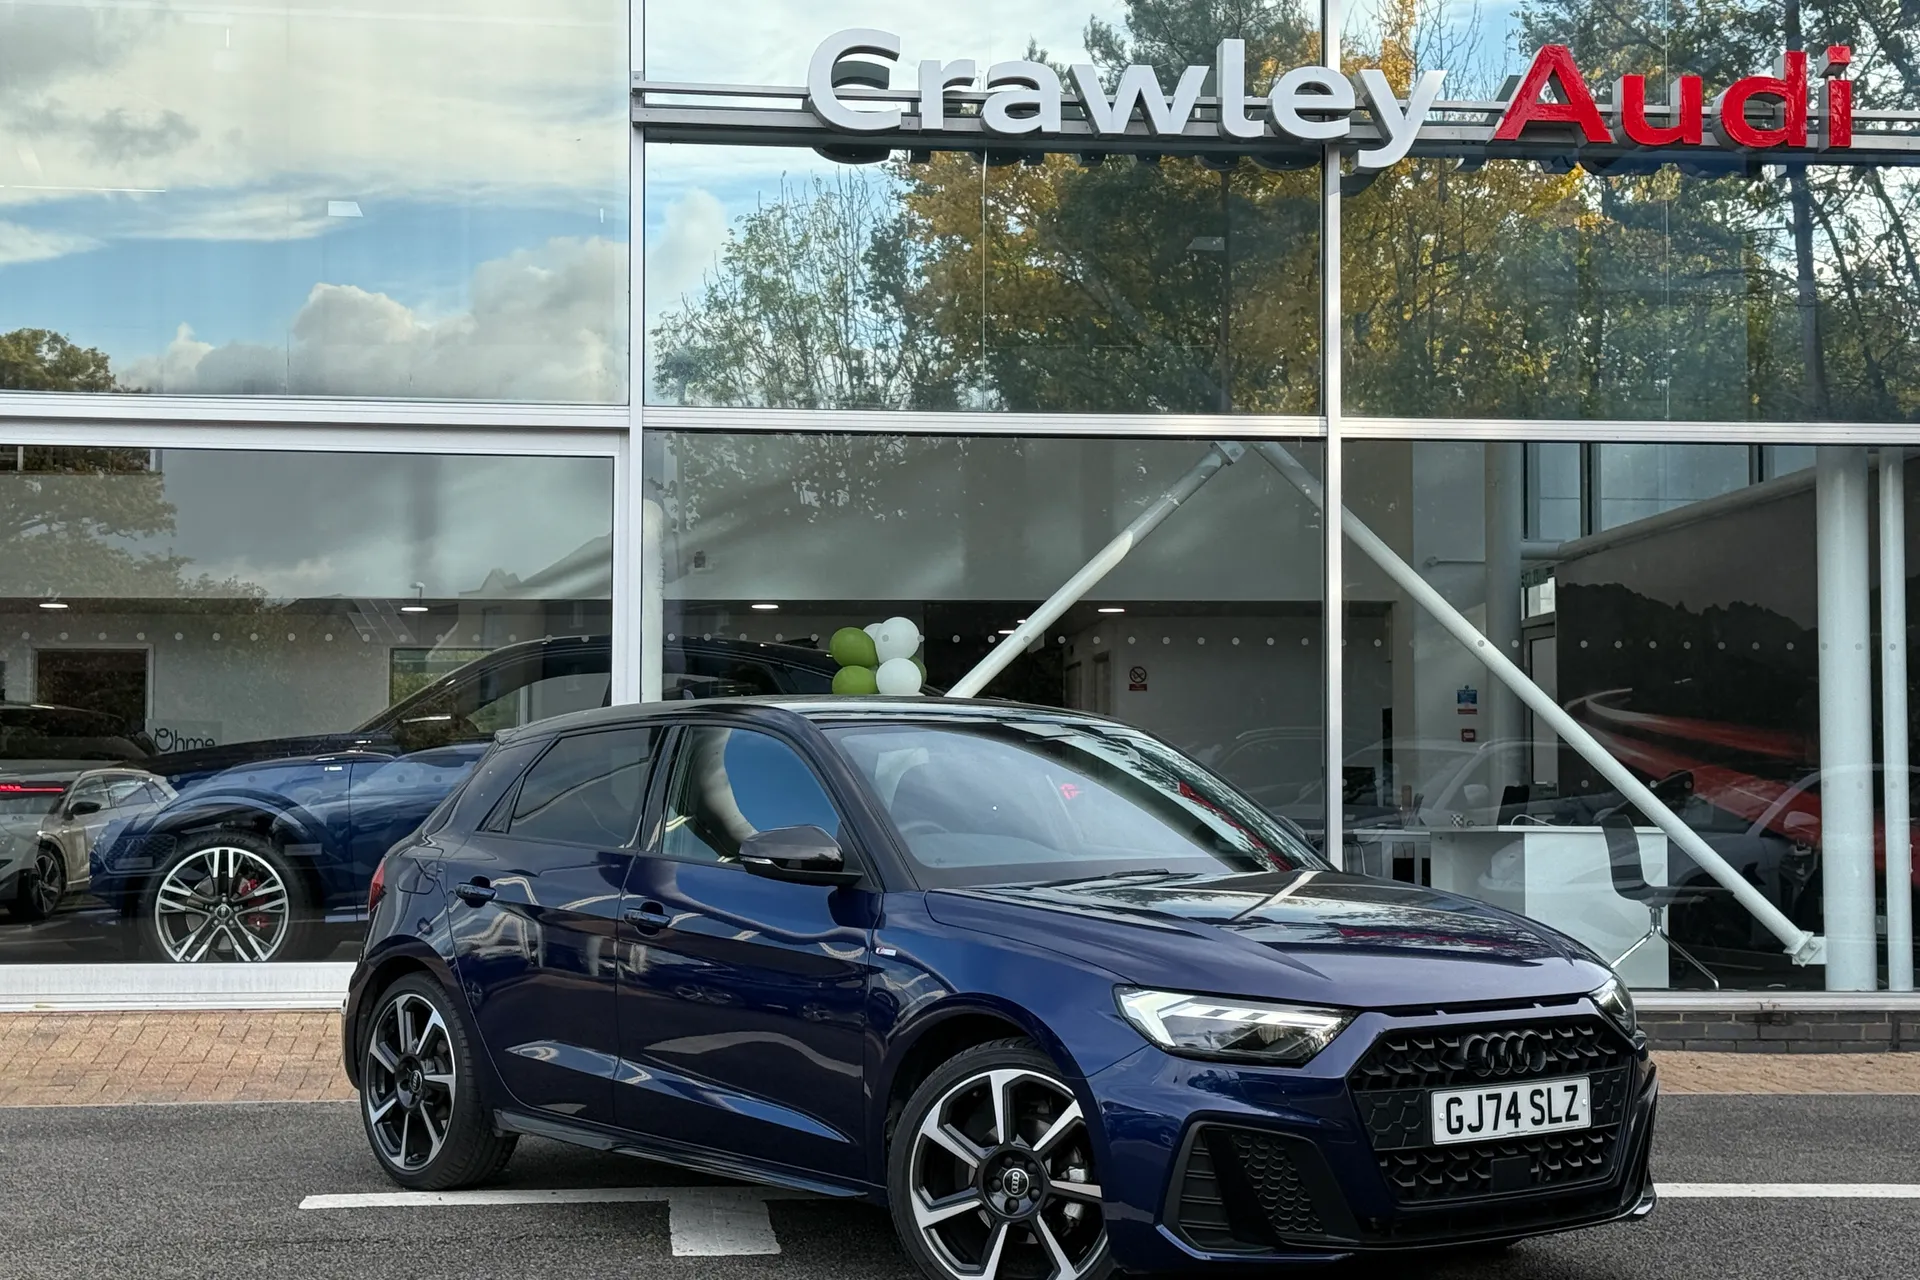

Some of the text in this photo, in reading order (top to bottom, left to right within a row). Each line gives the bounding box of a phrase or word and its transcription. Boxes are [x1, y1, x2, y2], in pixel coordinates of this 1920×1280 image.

[808, 28, 1852, 174] Crawley Audi
[1446, 1084, 1580, 1135] GJ74 SLZ
